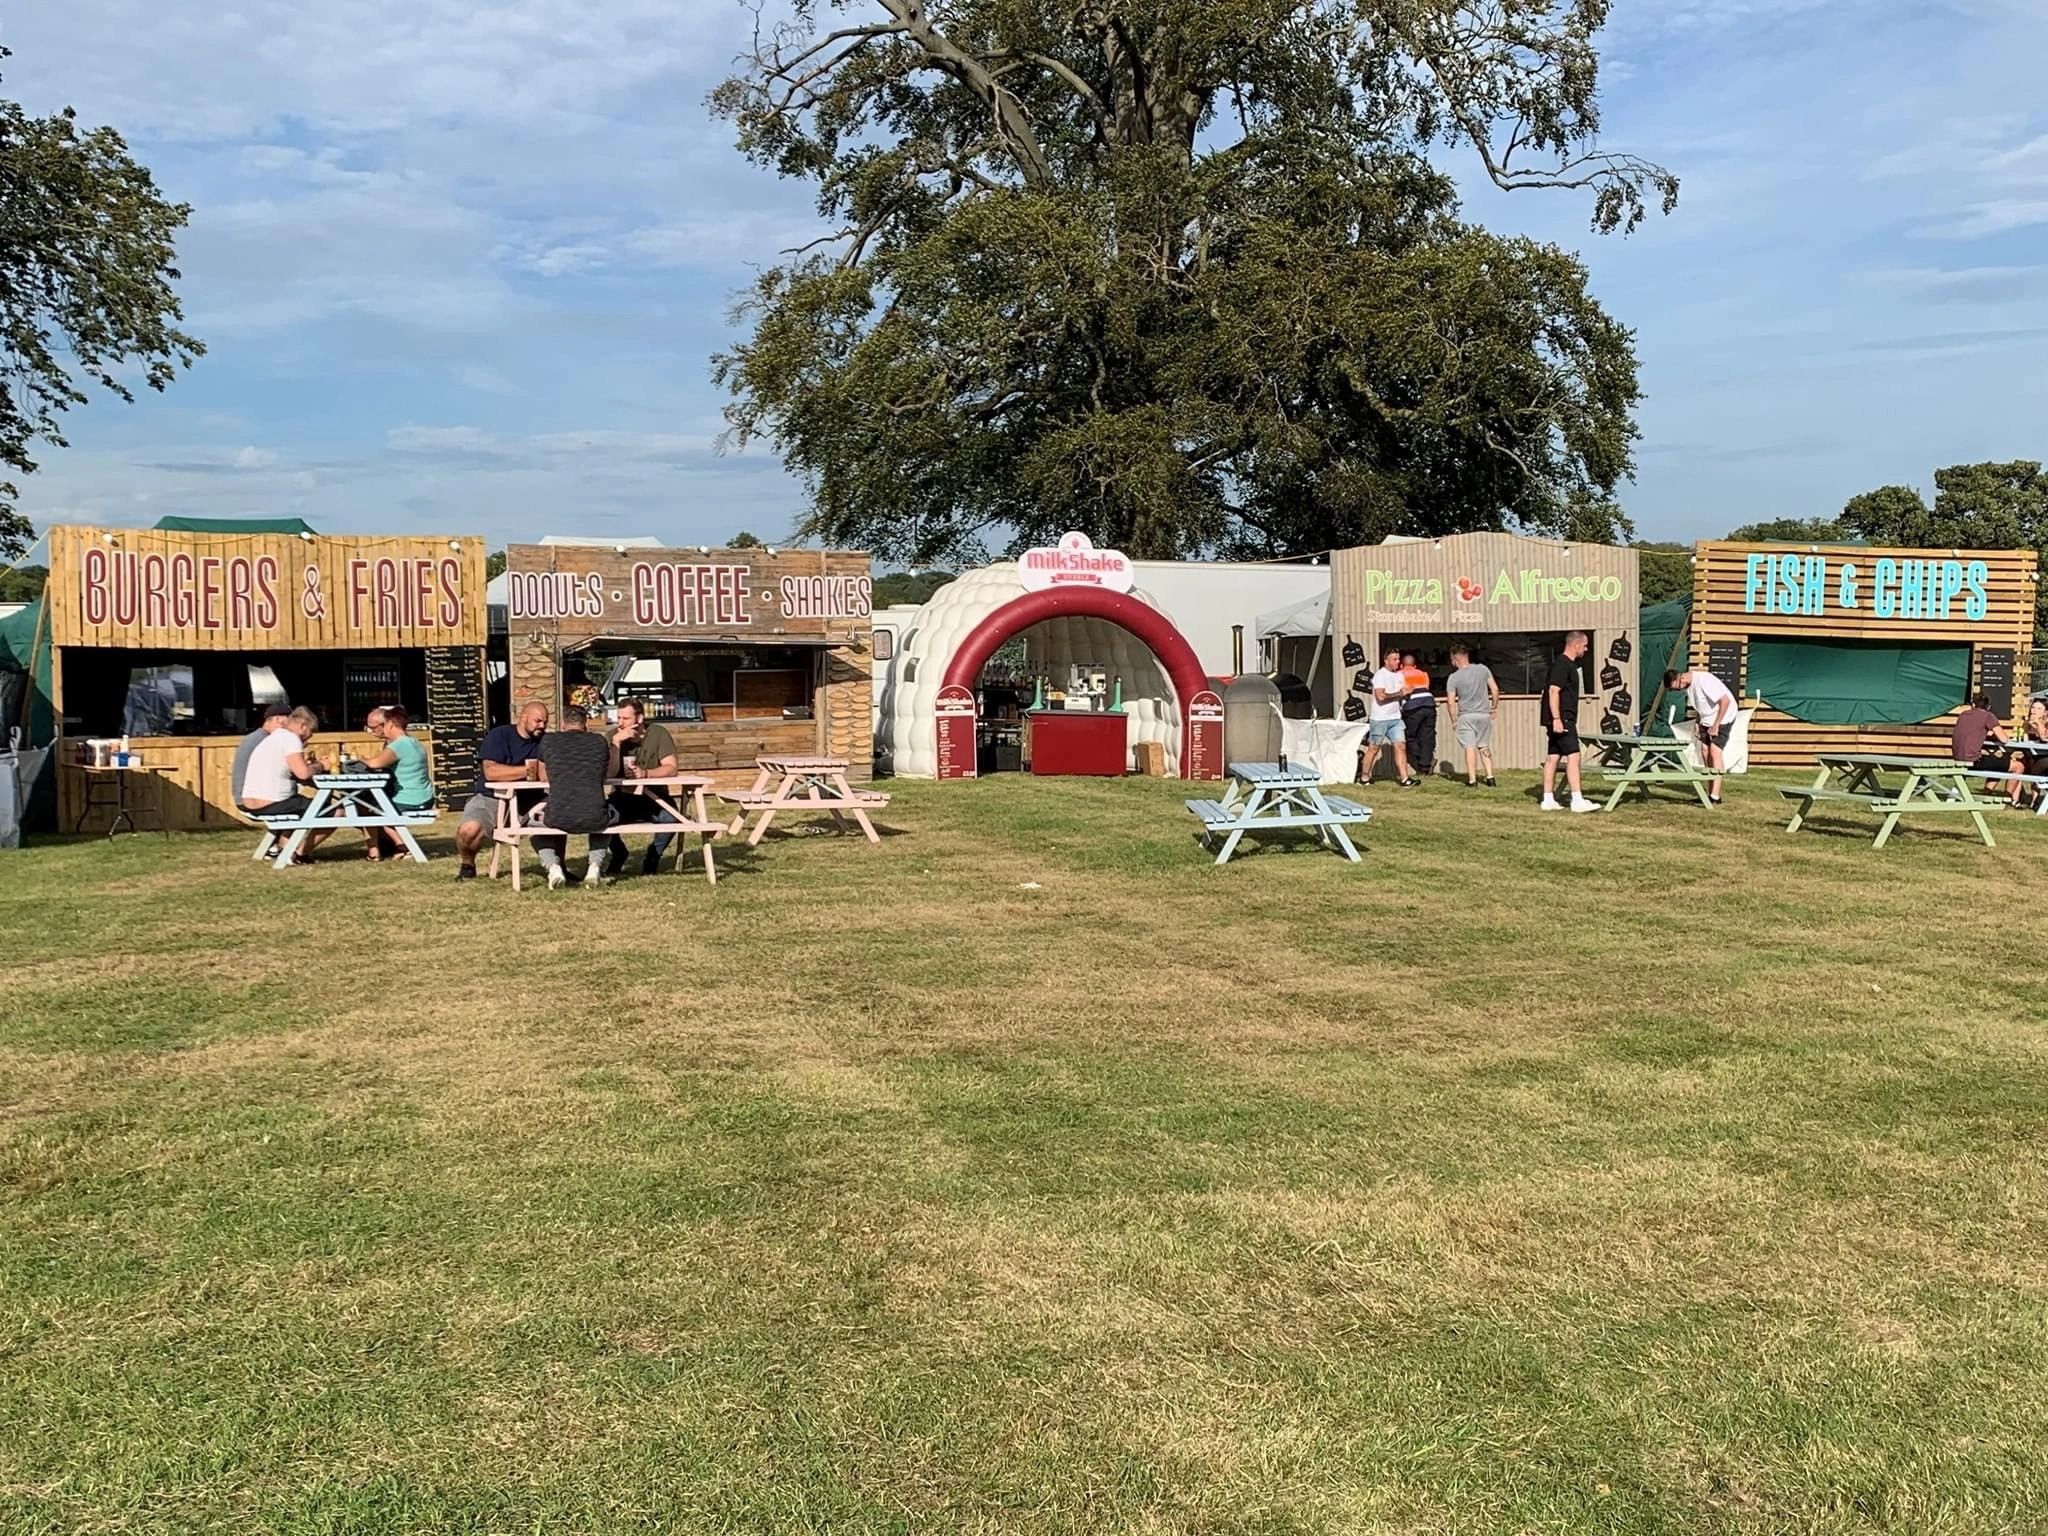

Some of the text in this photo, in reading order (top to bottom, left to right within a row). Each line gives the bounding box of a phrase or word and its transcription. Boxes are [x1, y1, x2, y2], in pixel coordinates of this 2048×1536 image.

[83, 548, 463, 631] BURGERS & FRIES
[632, 561, 752, 626] COFFEE
[780, 575, 872, 618] SHAKES
[1365, 568, 1622, 605] Pizza Alfresco
[1745, 554, 1988, 620] FISH & CHIPS
